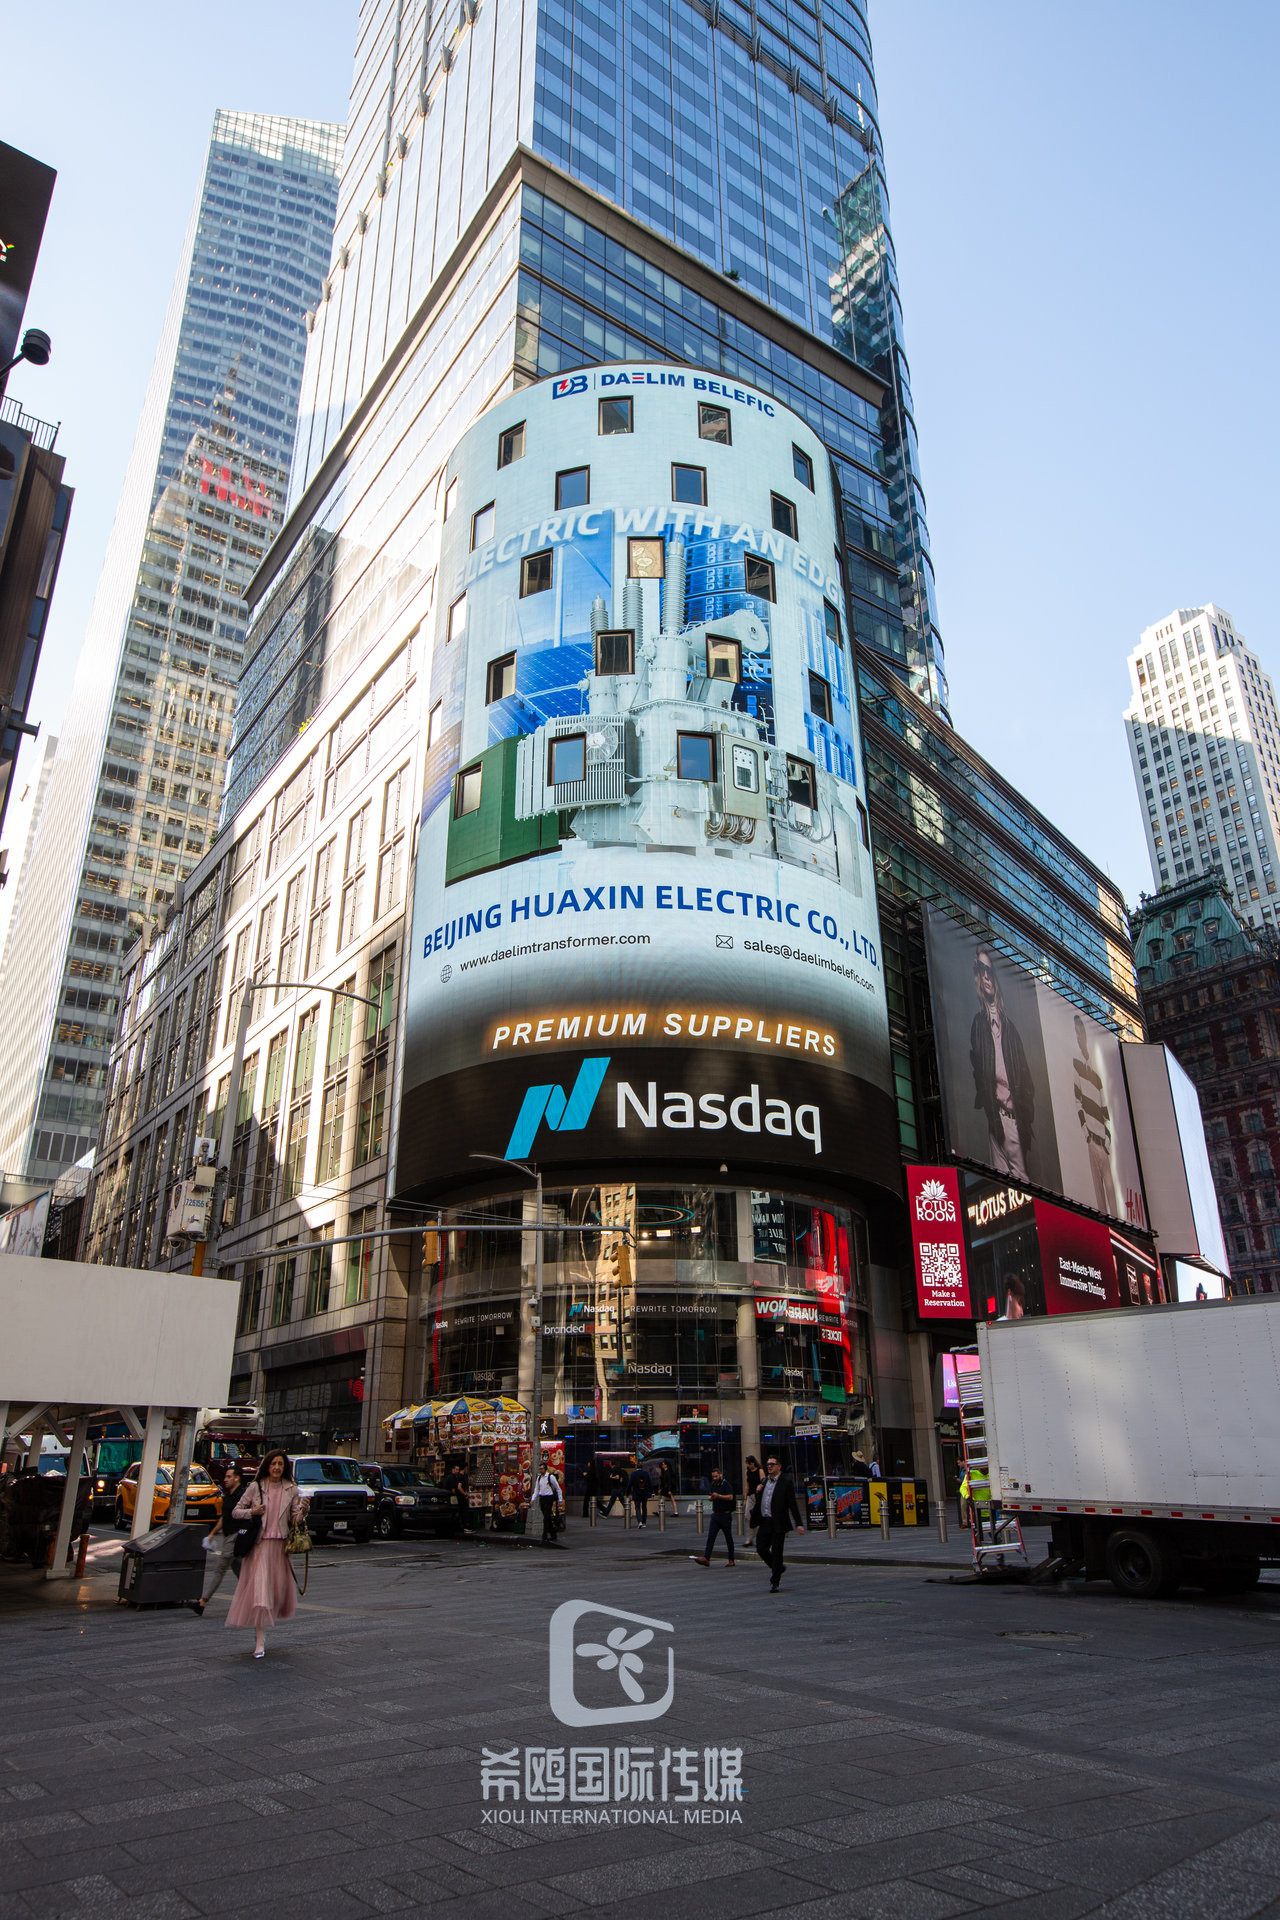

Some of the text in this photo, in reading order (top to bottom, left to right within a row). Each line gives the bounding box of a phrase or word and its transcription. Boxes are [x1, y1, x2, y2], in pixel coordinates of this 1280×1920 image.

[601, 372, 685, 388] DAELIM
[693, 376, 776, 418] BELEFIC
[453, 509, 603, 593] ELECTRIC
[614, 505, 723, 540] WITH
[730, 521, 785, 562] AN
[423, 885, 881, 972] BEIJING HUAXIN ELECTRIC CO., LTD.
[459, 934, 651, 972] www.daelimtransformer.com
[743, 939, 876, 995] sales@daelimbelefic.com
[492, 1013, 836, 1056] PREMIUM SUPPLIERS
[616, 1081, 823, 1155] Nasdaq
[915, 1199, 955, 1212] LOTUS
[917, 1208, 957, 1222] ROOM
[975, 1191, 1007, 1226] LOTUS
[1125, 1188, 1145, 1227] H&M
[931, 1289, 951, 1298] Make
[1058, 1273, 1088, 1293] Immersive
[1087, 1281, 1107, 1301] Dining
[454, 1316, 475, 1326] REWRITE
[477, 1311, 513, 1323] TOMORROW
[583, 1304, 718, 1315] Nasdaq REWRITE TOMORROW
[924, 1299, 965, 1307] Reservation
[628, 1363, 673, 1376] Nasdaq
[837, 1488, 863, 1515] AMAZE
